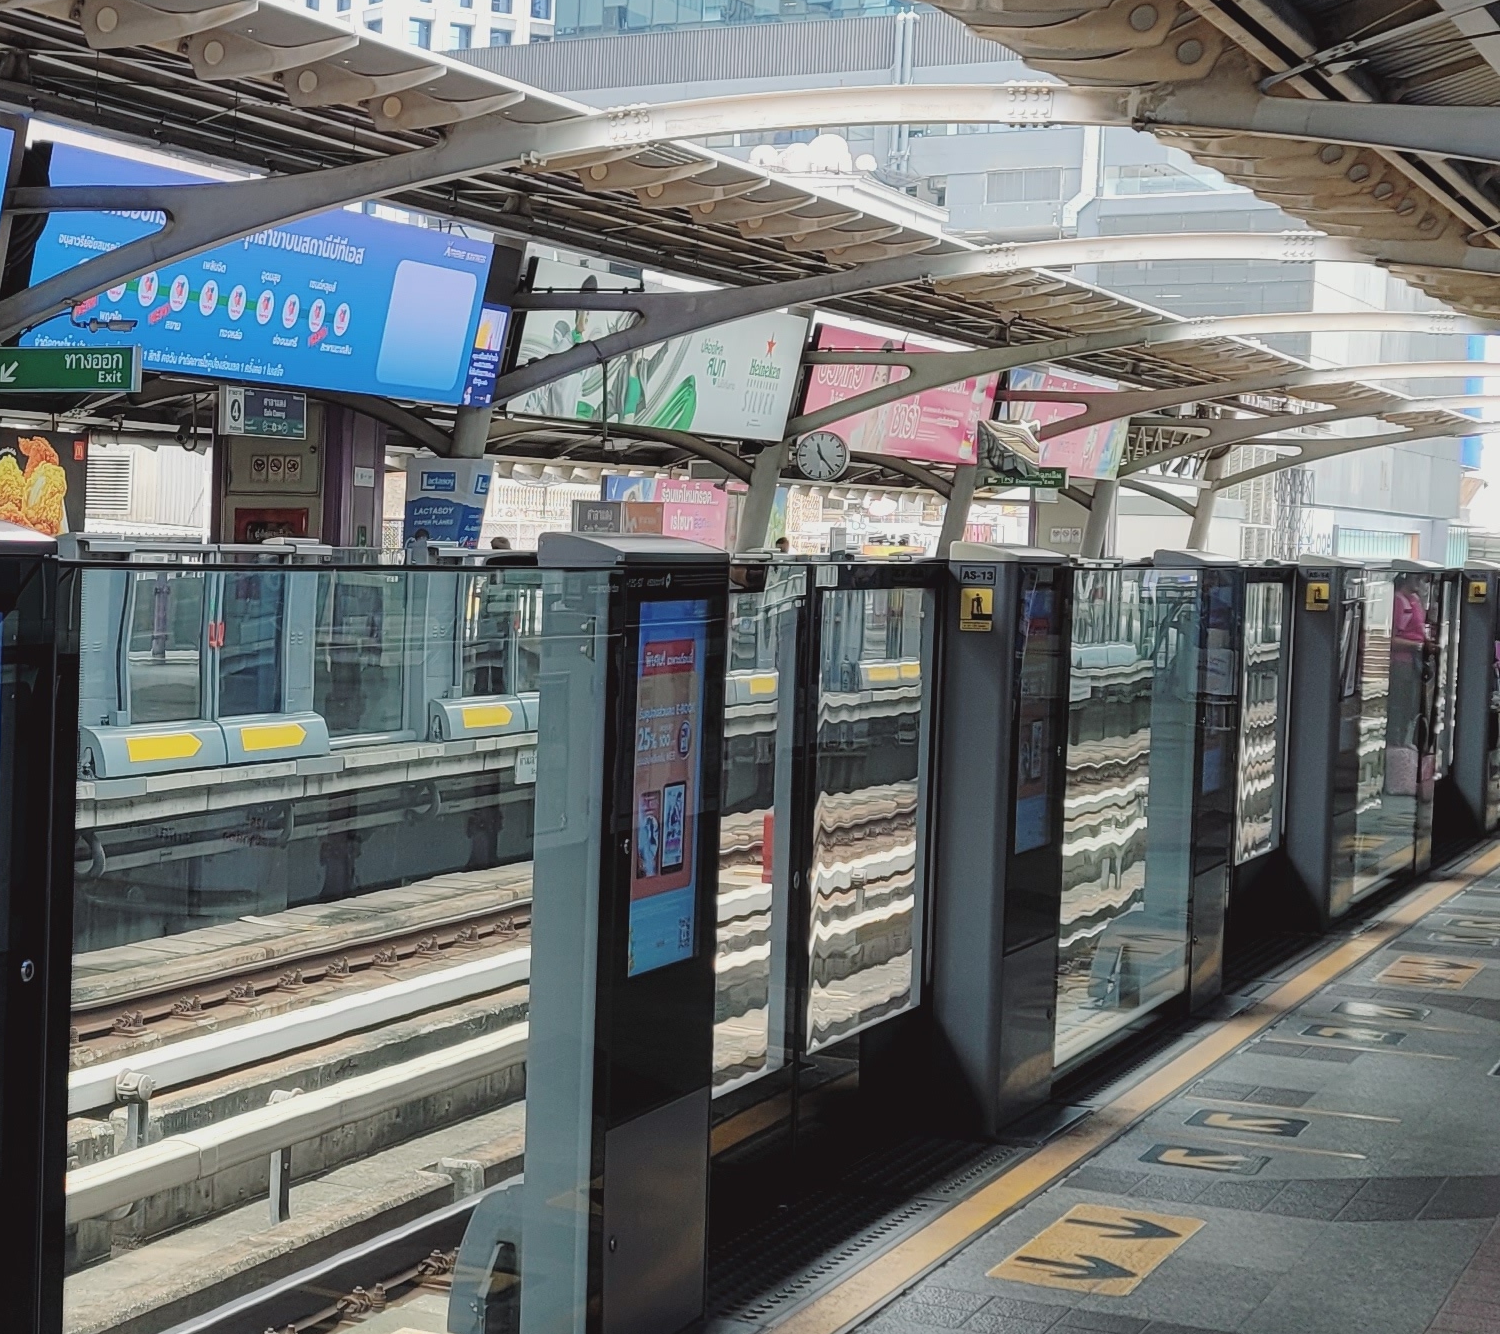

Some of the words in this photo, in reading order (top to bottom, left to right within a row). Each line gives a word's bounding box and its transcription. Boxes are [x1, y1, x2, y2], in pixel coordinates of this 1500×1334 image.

[64, 352, 123, 369] ทางออก
[97, 371, 122, 384] Exit
[231, 401, 240, 420] 4
[962, 570, 994, 581] AS-13
